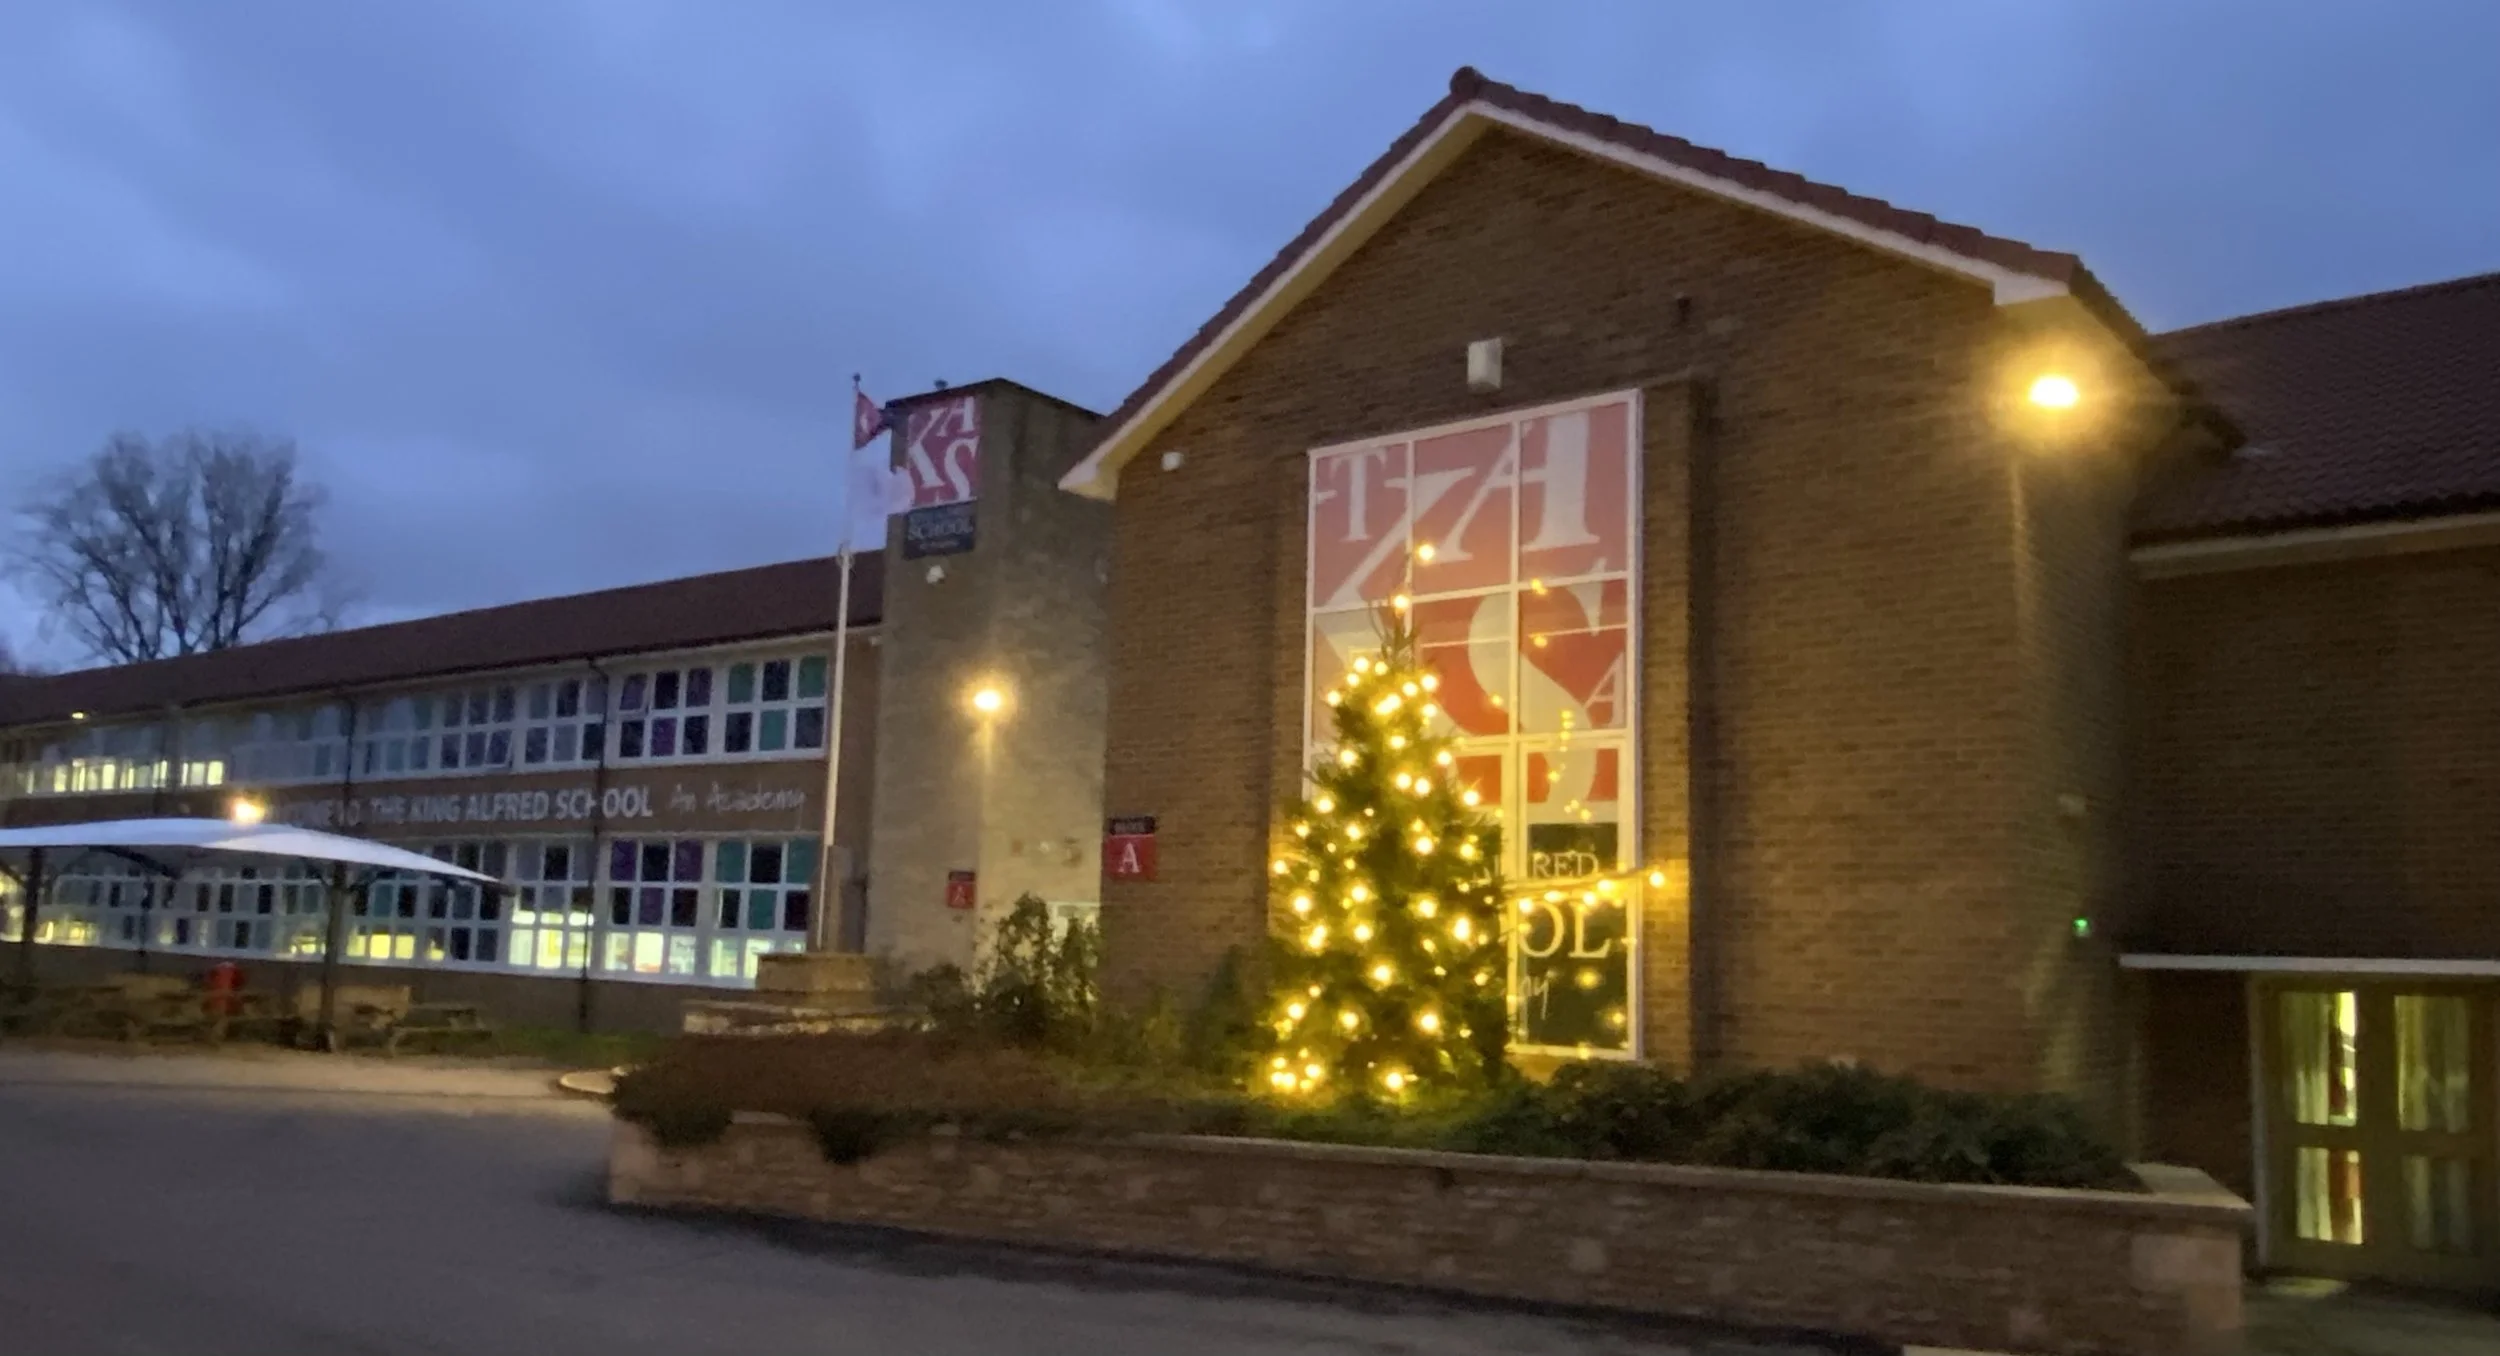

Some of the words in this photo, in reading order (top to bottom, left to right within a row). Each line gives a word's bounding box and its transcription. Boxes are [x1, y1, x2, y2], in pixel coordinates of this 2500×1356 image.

[371, 796, 406, 823] THE
[408, 794, 461, 822] KING
[465, 789, 550, 821] ALFRED
[555, 785, 654, 820] SCHOOL
[1117, 842, 1141, 873] A
